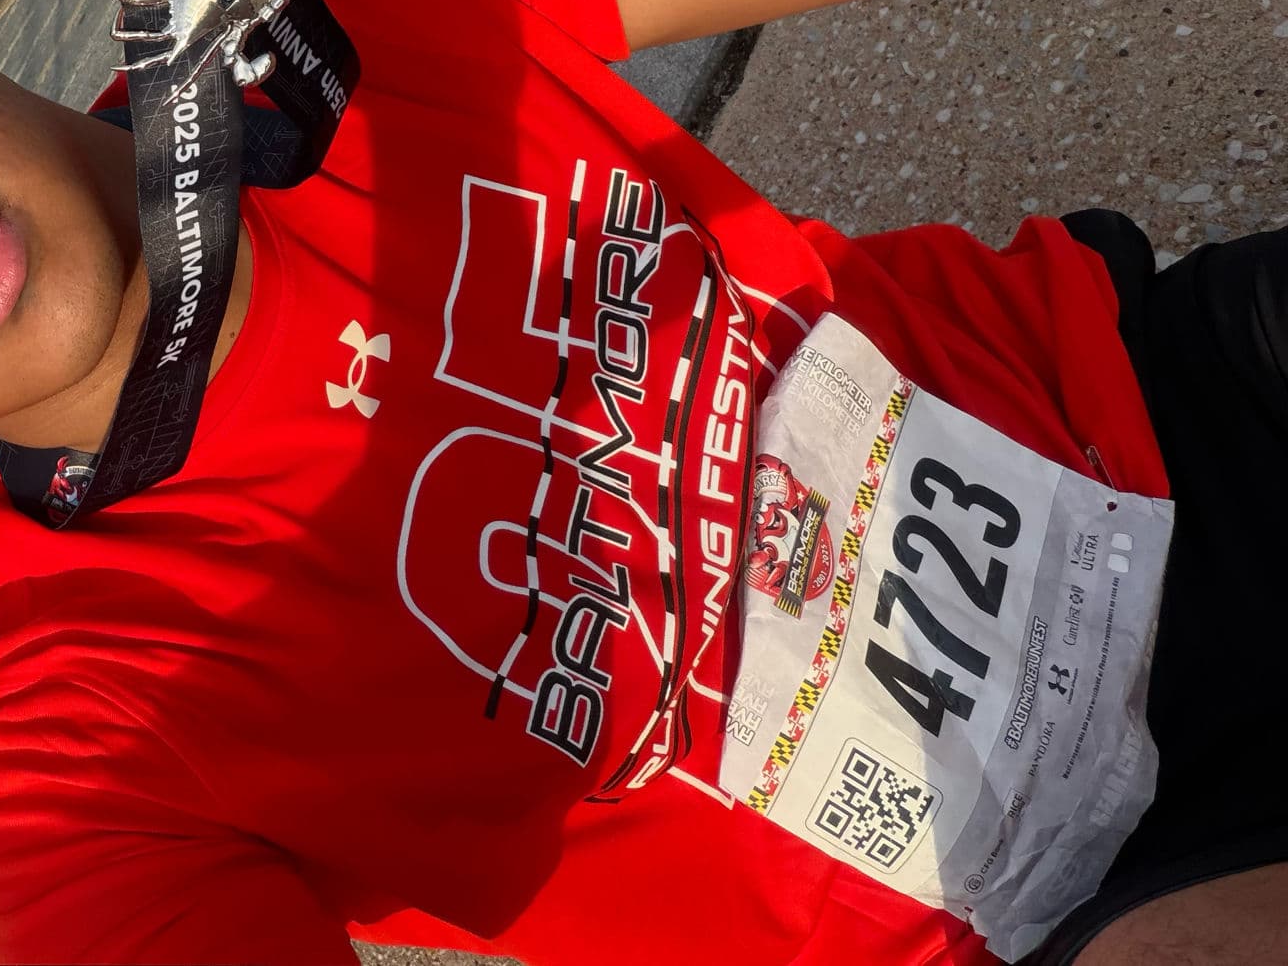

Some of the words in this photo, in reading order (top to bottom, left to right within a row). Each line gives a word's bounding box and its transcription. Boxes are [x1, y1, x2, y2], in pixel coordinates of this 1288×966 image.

[170, 83, 201, 163] 2025
[172, 169, 203, 335] BALTIMORE
[156, 337, 188, 369] 5K
[698, 286, 750, 504] FESTIV
[814, 353, 873, 415] KILOMETER
[808, 366, 867, 425] KILOMETER
[528, 167, 666, 769] BALTIMORE
[787, 506, 817, 594] BALTIMORE
[1081, 534, 1099, 571] ULTRA
[865, 457, 1021, 738] 4723
[1004, 616, 1049, 751] #BALTIMORERUNFEST
[1028, 721, 1056, 777] PANDORA
